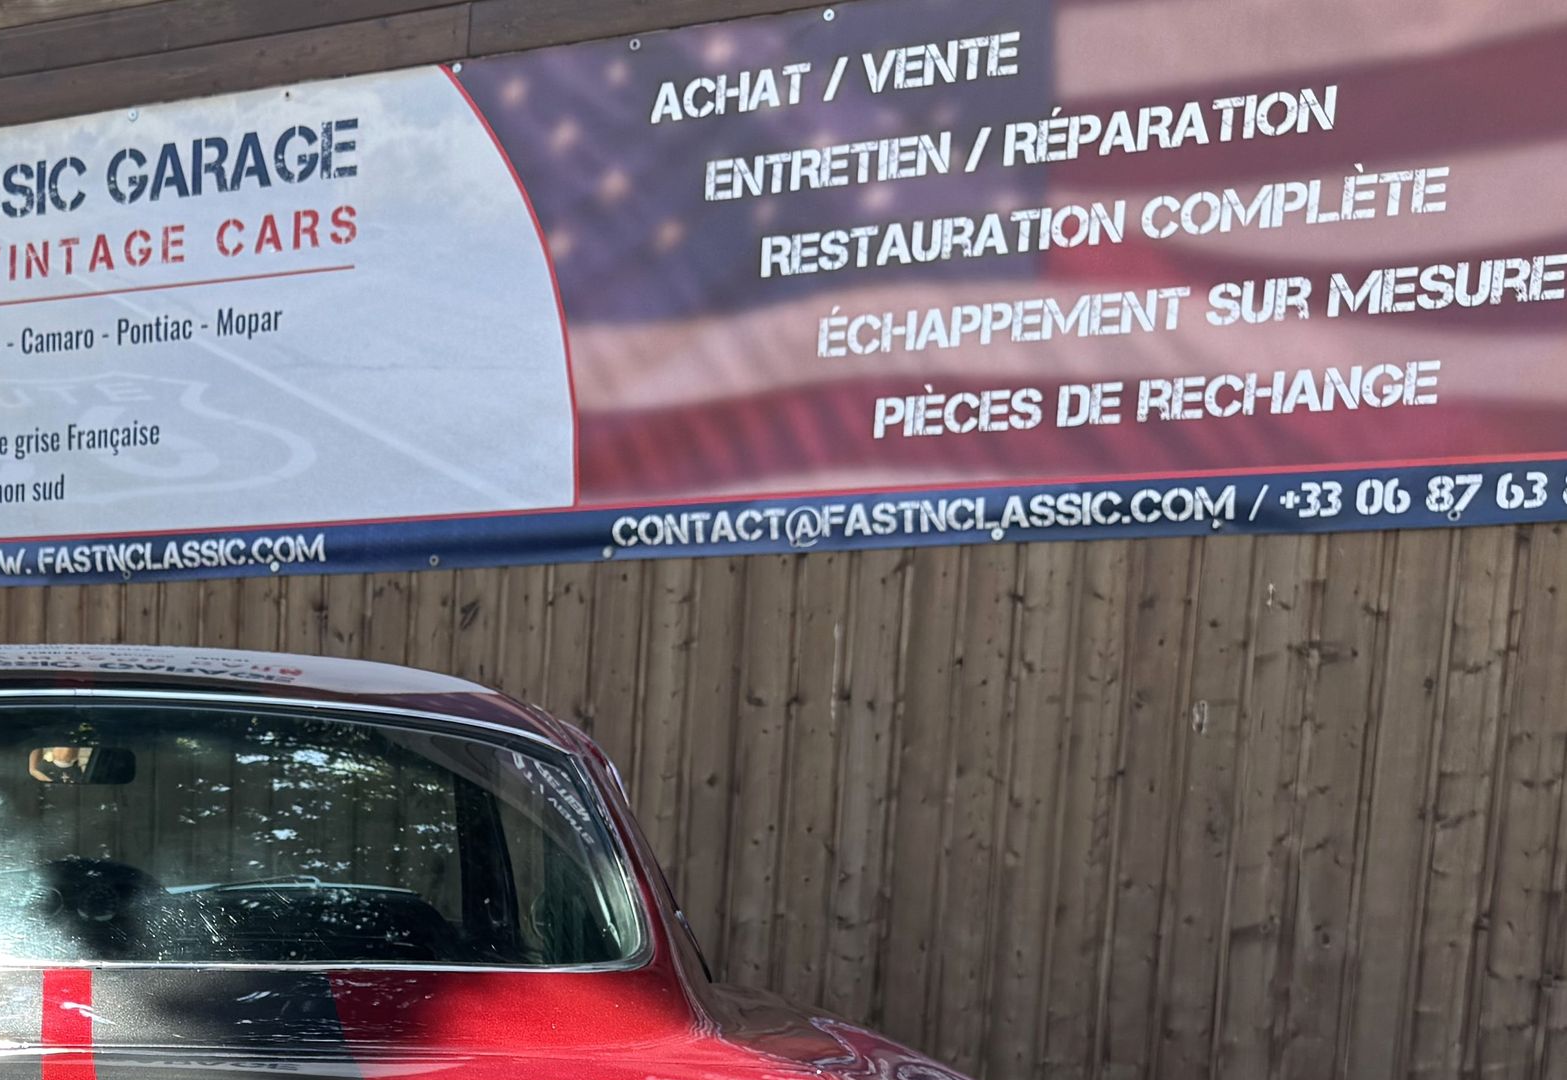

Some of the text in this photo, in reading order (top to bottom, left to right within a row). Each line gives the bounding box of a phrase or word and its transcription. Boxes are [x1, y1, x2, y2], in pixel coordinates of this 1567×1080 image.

[650, 31, 1020, 124] ACHAT / VENTE
[106, 117, 359, 205] GARAGE
[704, 85, 1337, 201] ENTRETIEN / RÉPARATION
[216, 205, 357, 257] CARS
[760, 163, 1449, 278] RESTAURATION COMPLÈTE
[21, 327, 94, 354] Camaro
[116, 315, 192, 346] Pontiac
[216, 307, 282, 339] Mopar
[817, 253, 1567, 358] ÉCHAPPEMENT SUR MESURE
[873, 360, 1440, 439] PIÈCES DE RECHANGE
[15, 427, 60, 460] grise
[68, 419, 160, 456] Française
[32, 473, 65, 501] sud
[611, 484, 1236, 548] CONTACT@FASTNCLASSIC.COM
[1249, 483, 1269, 522] /
[1280, 481, 1343, 518] +33
[1355, 477, 1412, 516] 06
[1425, 473, 1483, 513] 87
[1495, 471, 1548, 510] 63
